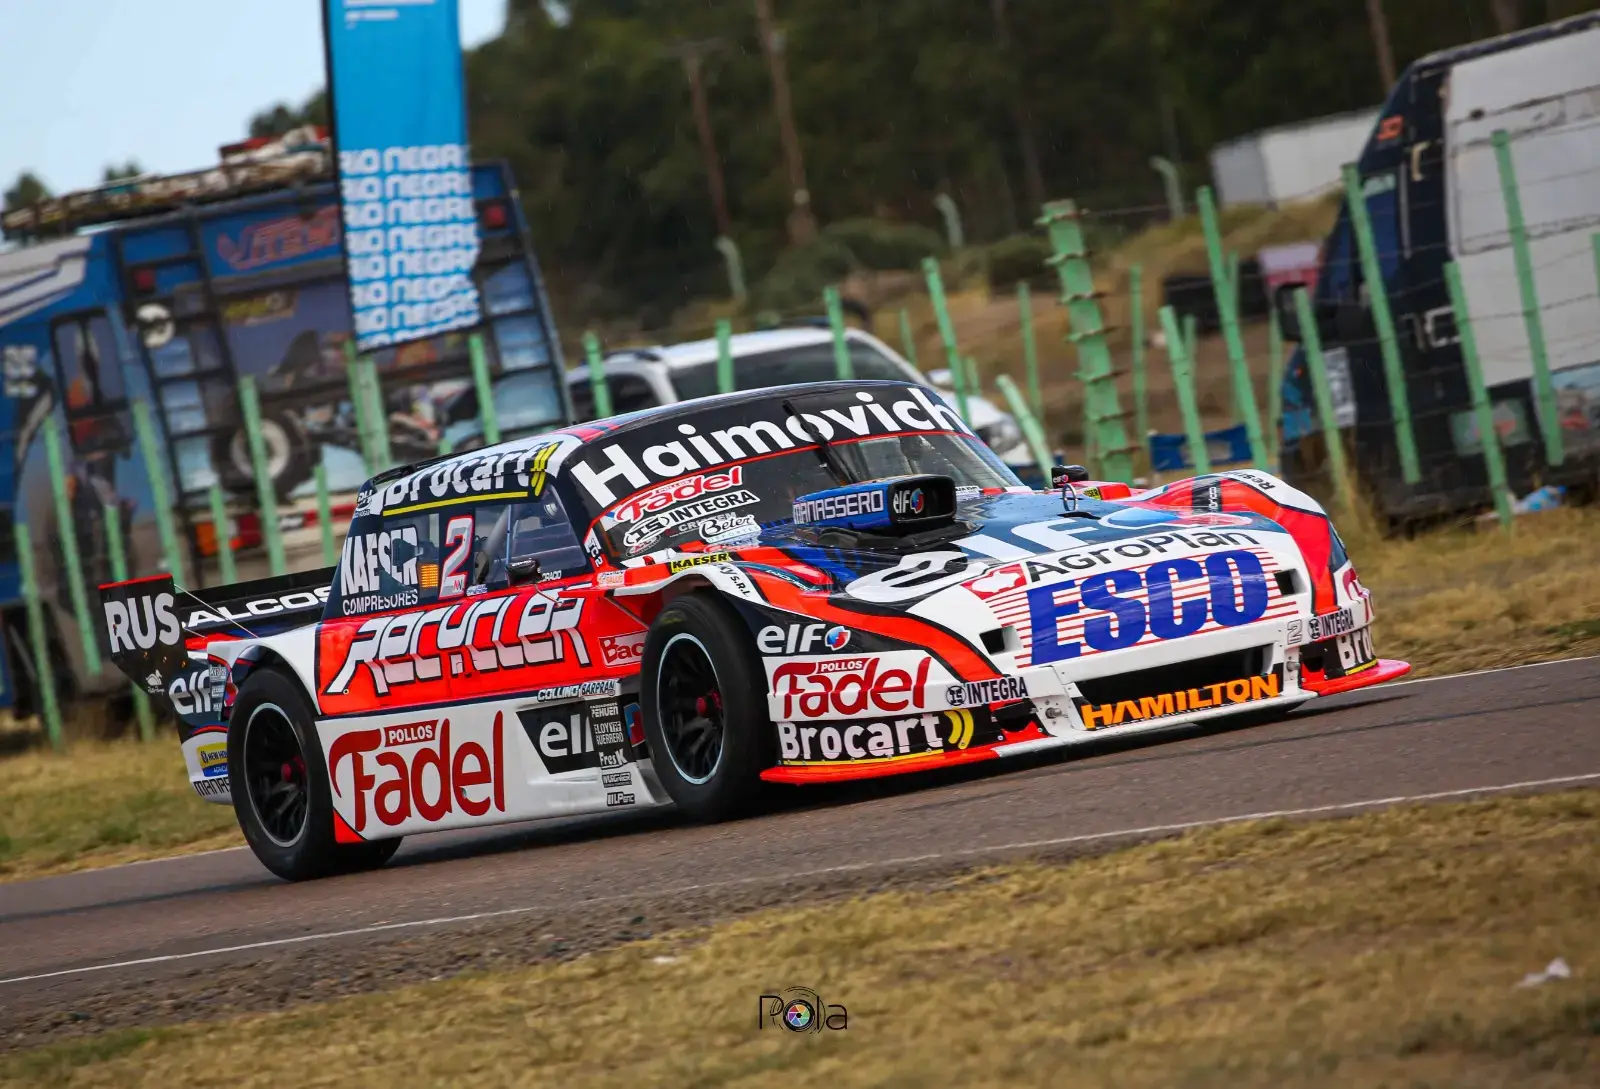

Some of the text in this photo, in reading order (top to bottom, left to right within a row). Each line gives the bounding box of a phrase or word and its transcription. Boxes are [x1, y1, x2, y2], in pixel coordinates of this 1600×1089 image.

[570, 388, 975, 510] Haimovich
[616, 467, 741, 520] Fadel
[669, 491, 756, 522] INTEGRA
[793, 490, 884, 525] MANASSERO
[893, 490, 911, 514] elf
[341, 526, 418, 596] KAESER
[438, 515, 475, 600] 2
[673, 552, 728, 569] KAESER
[104, 592, 181, 653] RUS
[342, 589, 418, 616] COMPRESORES
[1027, 549, 1268, 666] ESCO
[1321, 608, 1355, 637] INTEGRA
[757, 623, 826, 654] elf
[773, 656, 932, 719] Fadel
[821, 660, 863, 673] POLLOS
[169, 670, 211, 715] elf
[967, 676, 1029, 704] INTEGRA
[1081, 673, 1279, 729] HAMILTON
[389, 725, 433, 745] POLLOS
[777, 712, 944, 760] Brocart
[329, 710, 506, 832] Fadel
